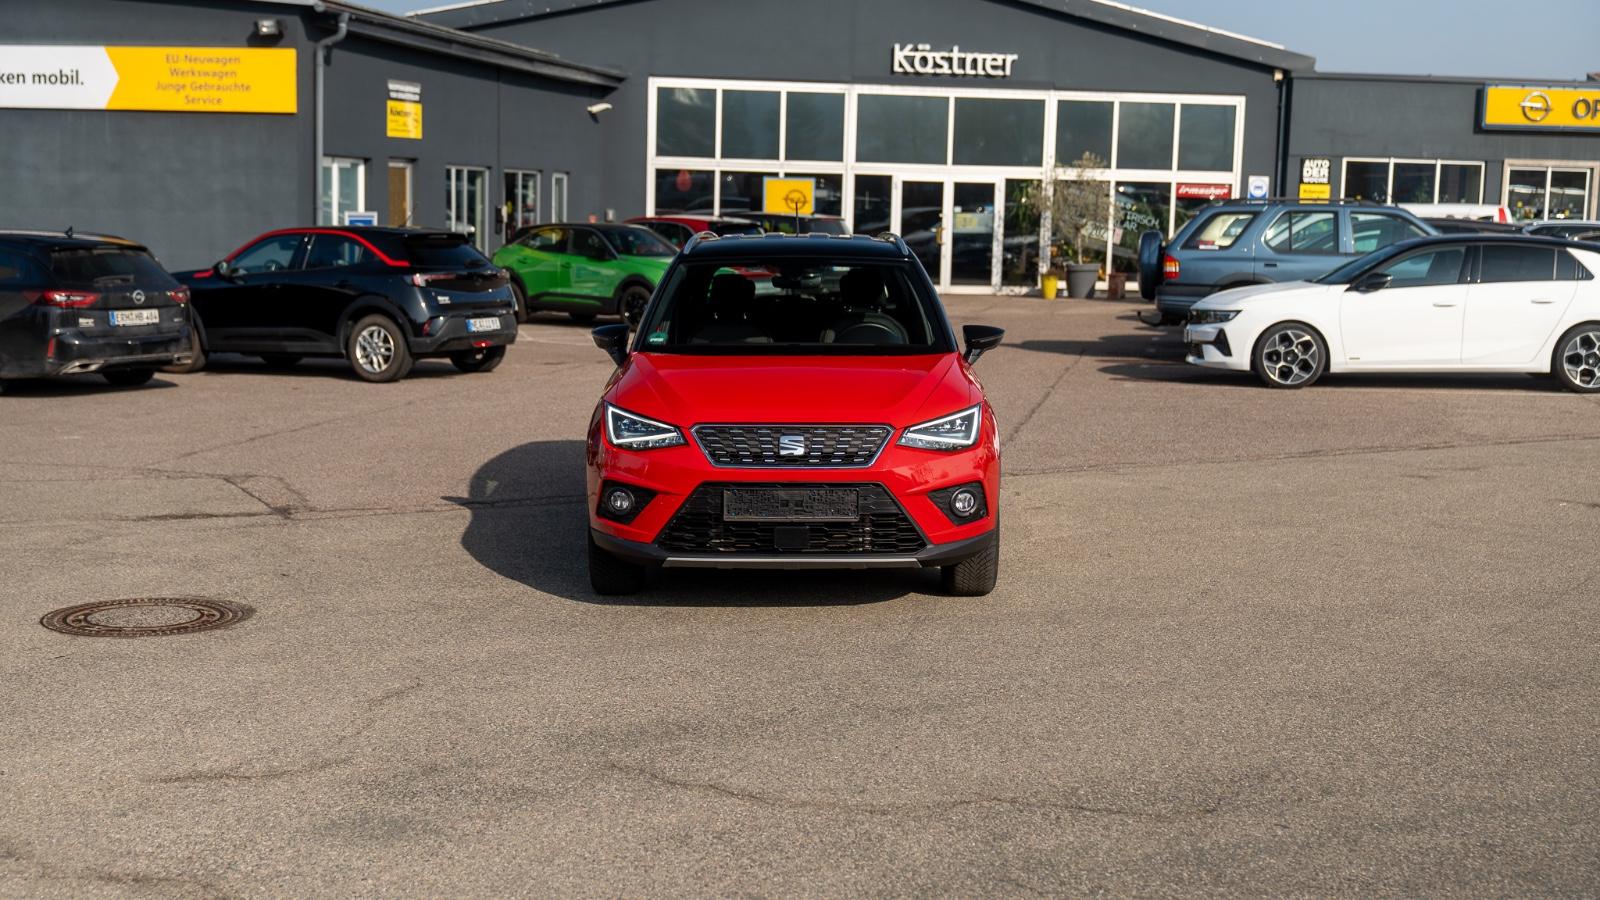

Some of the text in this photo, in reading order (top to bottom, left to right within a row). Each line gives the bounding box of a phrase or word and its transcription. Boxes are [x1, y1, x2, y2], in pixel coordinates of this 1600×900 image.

[893, 43, 1019, 76] Köstner
[32, 68, 84, 85] mobil.
[169, 67, 237, 80] Werkswagen
[156, 81, 251, 94] Junge Gebrauchte
[184, 94, 223, 105] Service
[1303, 158, 1330, 169] AUTO
[1303, 168, 1329, 178] DER
